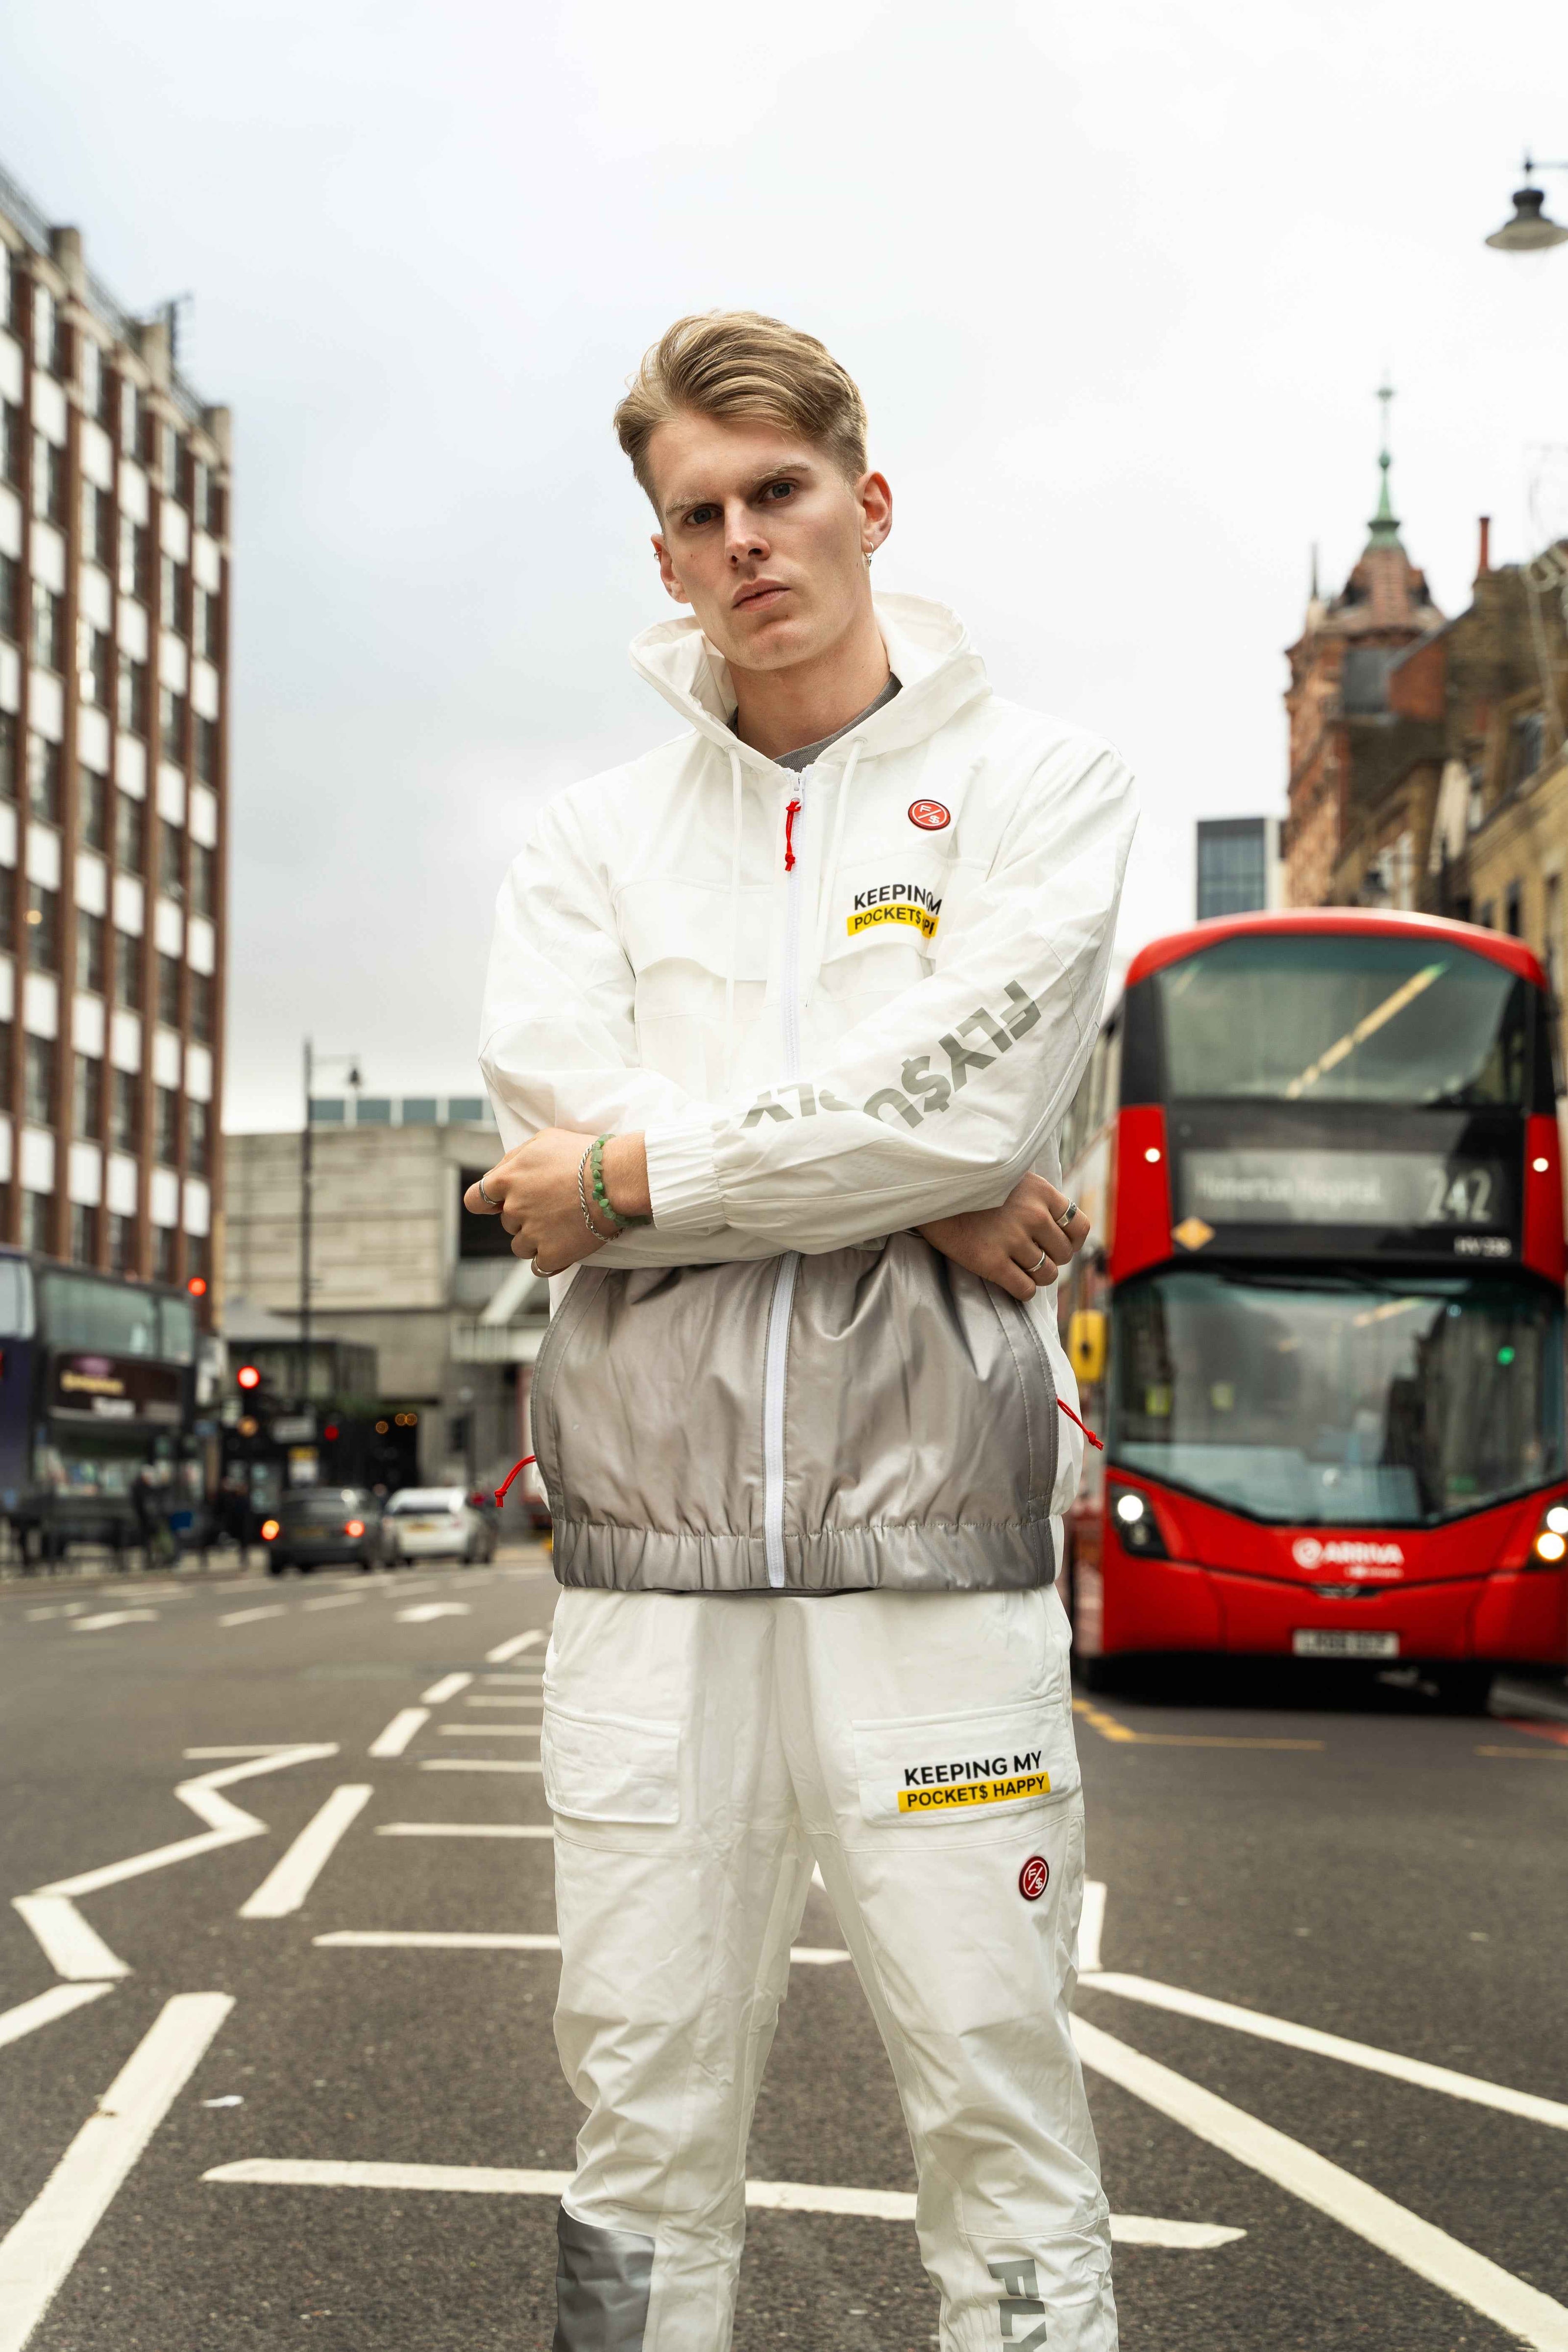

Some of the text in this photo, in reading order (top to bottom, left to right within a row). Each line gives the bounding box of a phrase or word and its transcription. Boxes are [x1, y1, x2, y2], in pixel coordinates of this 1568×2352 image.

[1422, 1166, 1492, 1223] 242
[1323, 1542, 1404, 1565] ARRIVA
[905, 1751, 1042, 1786] KEEPING MY
[907, 1776, 1045, 1808] POCKET$ HAPPY
